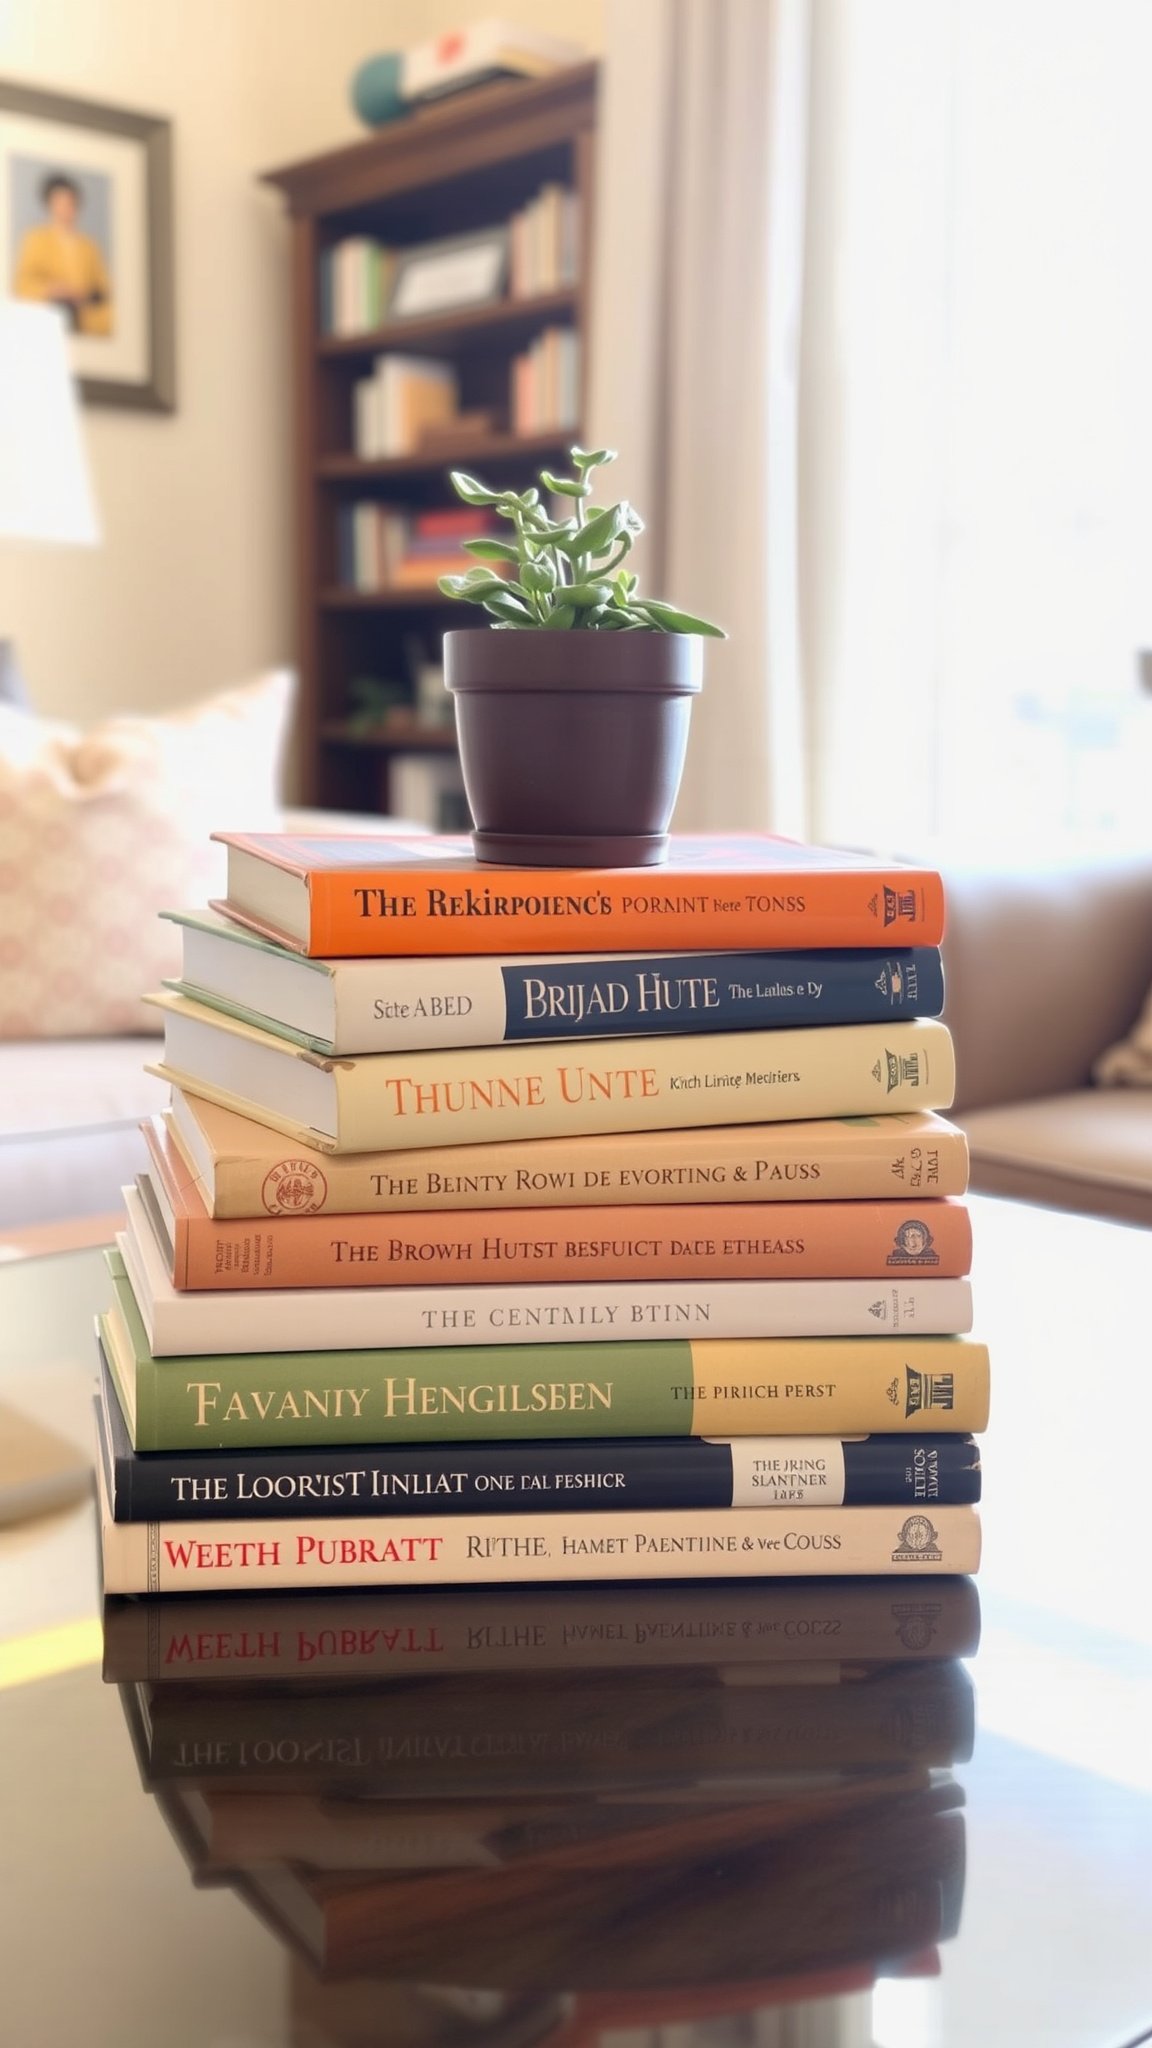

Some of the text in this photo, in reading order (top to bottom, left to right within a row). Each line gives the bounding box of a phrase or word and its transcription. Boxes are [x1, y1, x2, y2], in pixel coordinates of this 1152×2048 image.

[745, 895, 806, 913] TONSS
[523, 978, 629, 1023] BRIJAD
[635, 972, 720, 1013] HUTE
[728, 983, 752, 999] The
[385, 1075, 546, 1117] THUNNE
[556, 1066, 660, 1104] UNTE
[370, 1174, 418, 1196] THE
[426, 1172, 508, 1195] BEINTY
[584, 1170, 611, 1187] DE
[620, 1166, 726, 1186] EVORTING
[733, 1166, 748, 1182] &
[755, 1160, 821, 1181] PAUSS
[331, 1240, 379, 1262] THE
[387, 1239, 473, 1262] BROWH
[481, 1237, 558, 1260] HUTST
[723, 1239, 805, 1256] ETHEASS
[422, 1310, 476, 1328] THE
[630, 1303, 711, 1323] BTINN
[187, 1382, 370, 1427] FAVANIY
[671, 1386, 708, 1400] THE
[785, 1384, 837, 1398] PERST
[753, 1459, 781, 1472] THE
[171, 1477, 228, 1501] THE
[474, 1475, 515, 1492] ONE
[164, 1540, 280, 1568] WEETH
[296, 1535, 443, 1566] PUBRATT
[562, 1536, 629, 1555] HAMET
[742, 1536, 754, 1551] &
[783, 1532, 842, 1551] COUSS
